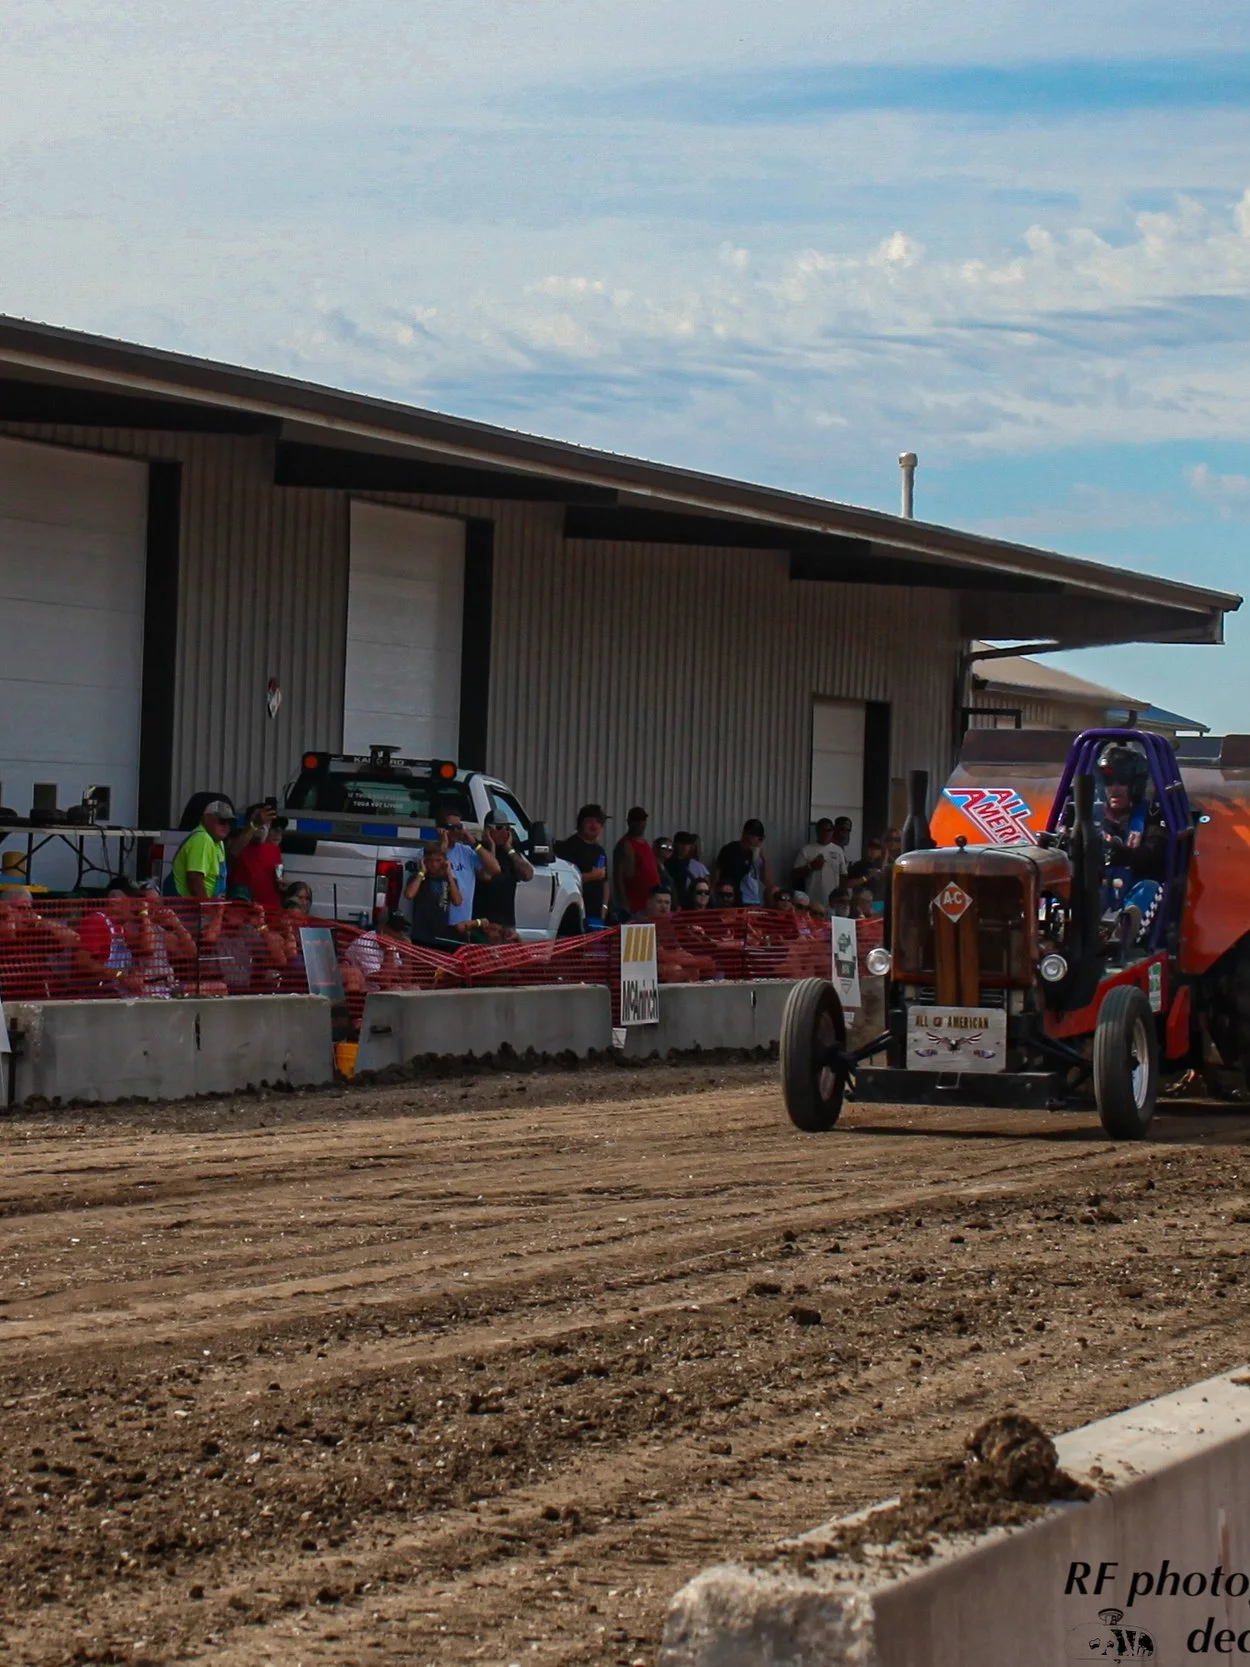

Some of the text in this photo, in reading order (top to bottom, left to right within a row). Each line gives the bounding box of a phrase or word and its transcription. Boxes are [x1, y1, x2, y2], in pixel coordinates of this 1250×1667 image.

[948, 790, 1022, 844] AMERI
[988, 790, 1038, 845] ALL
[915, 1015, 989, 1029] ALL AMERICAN
